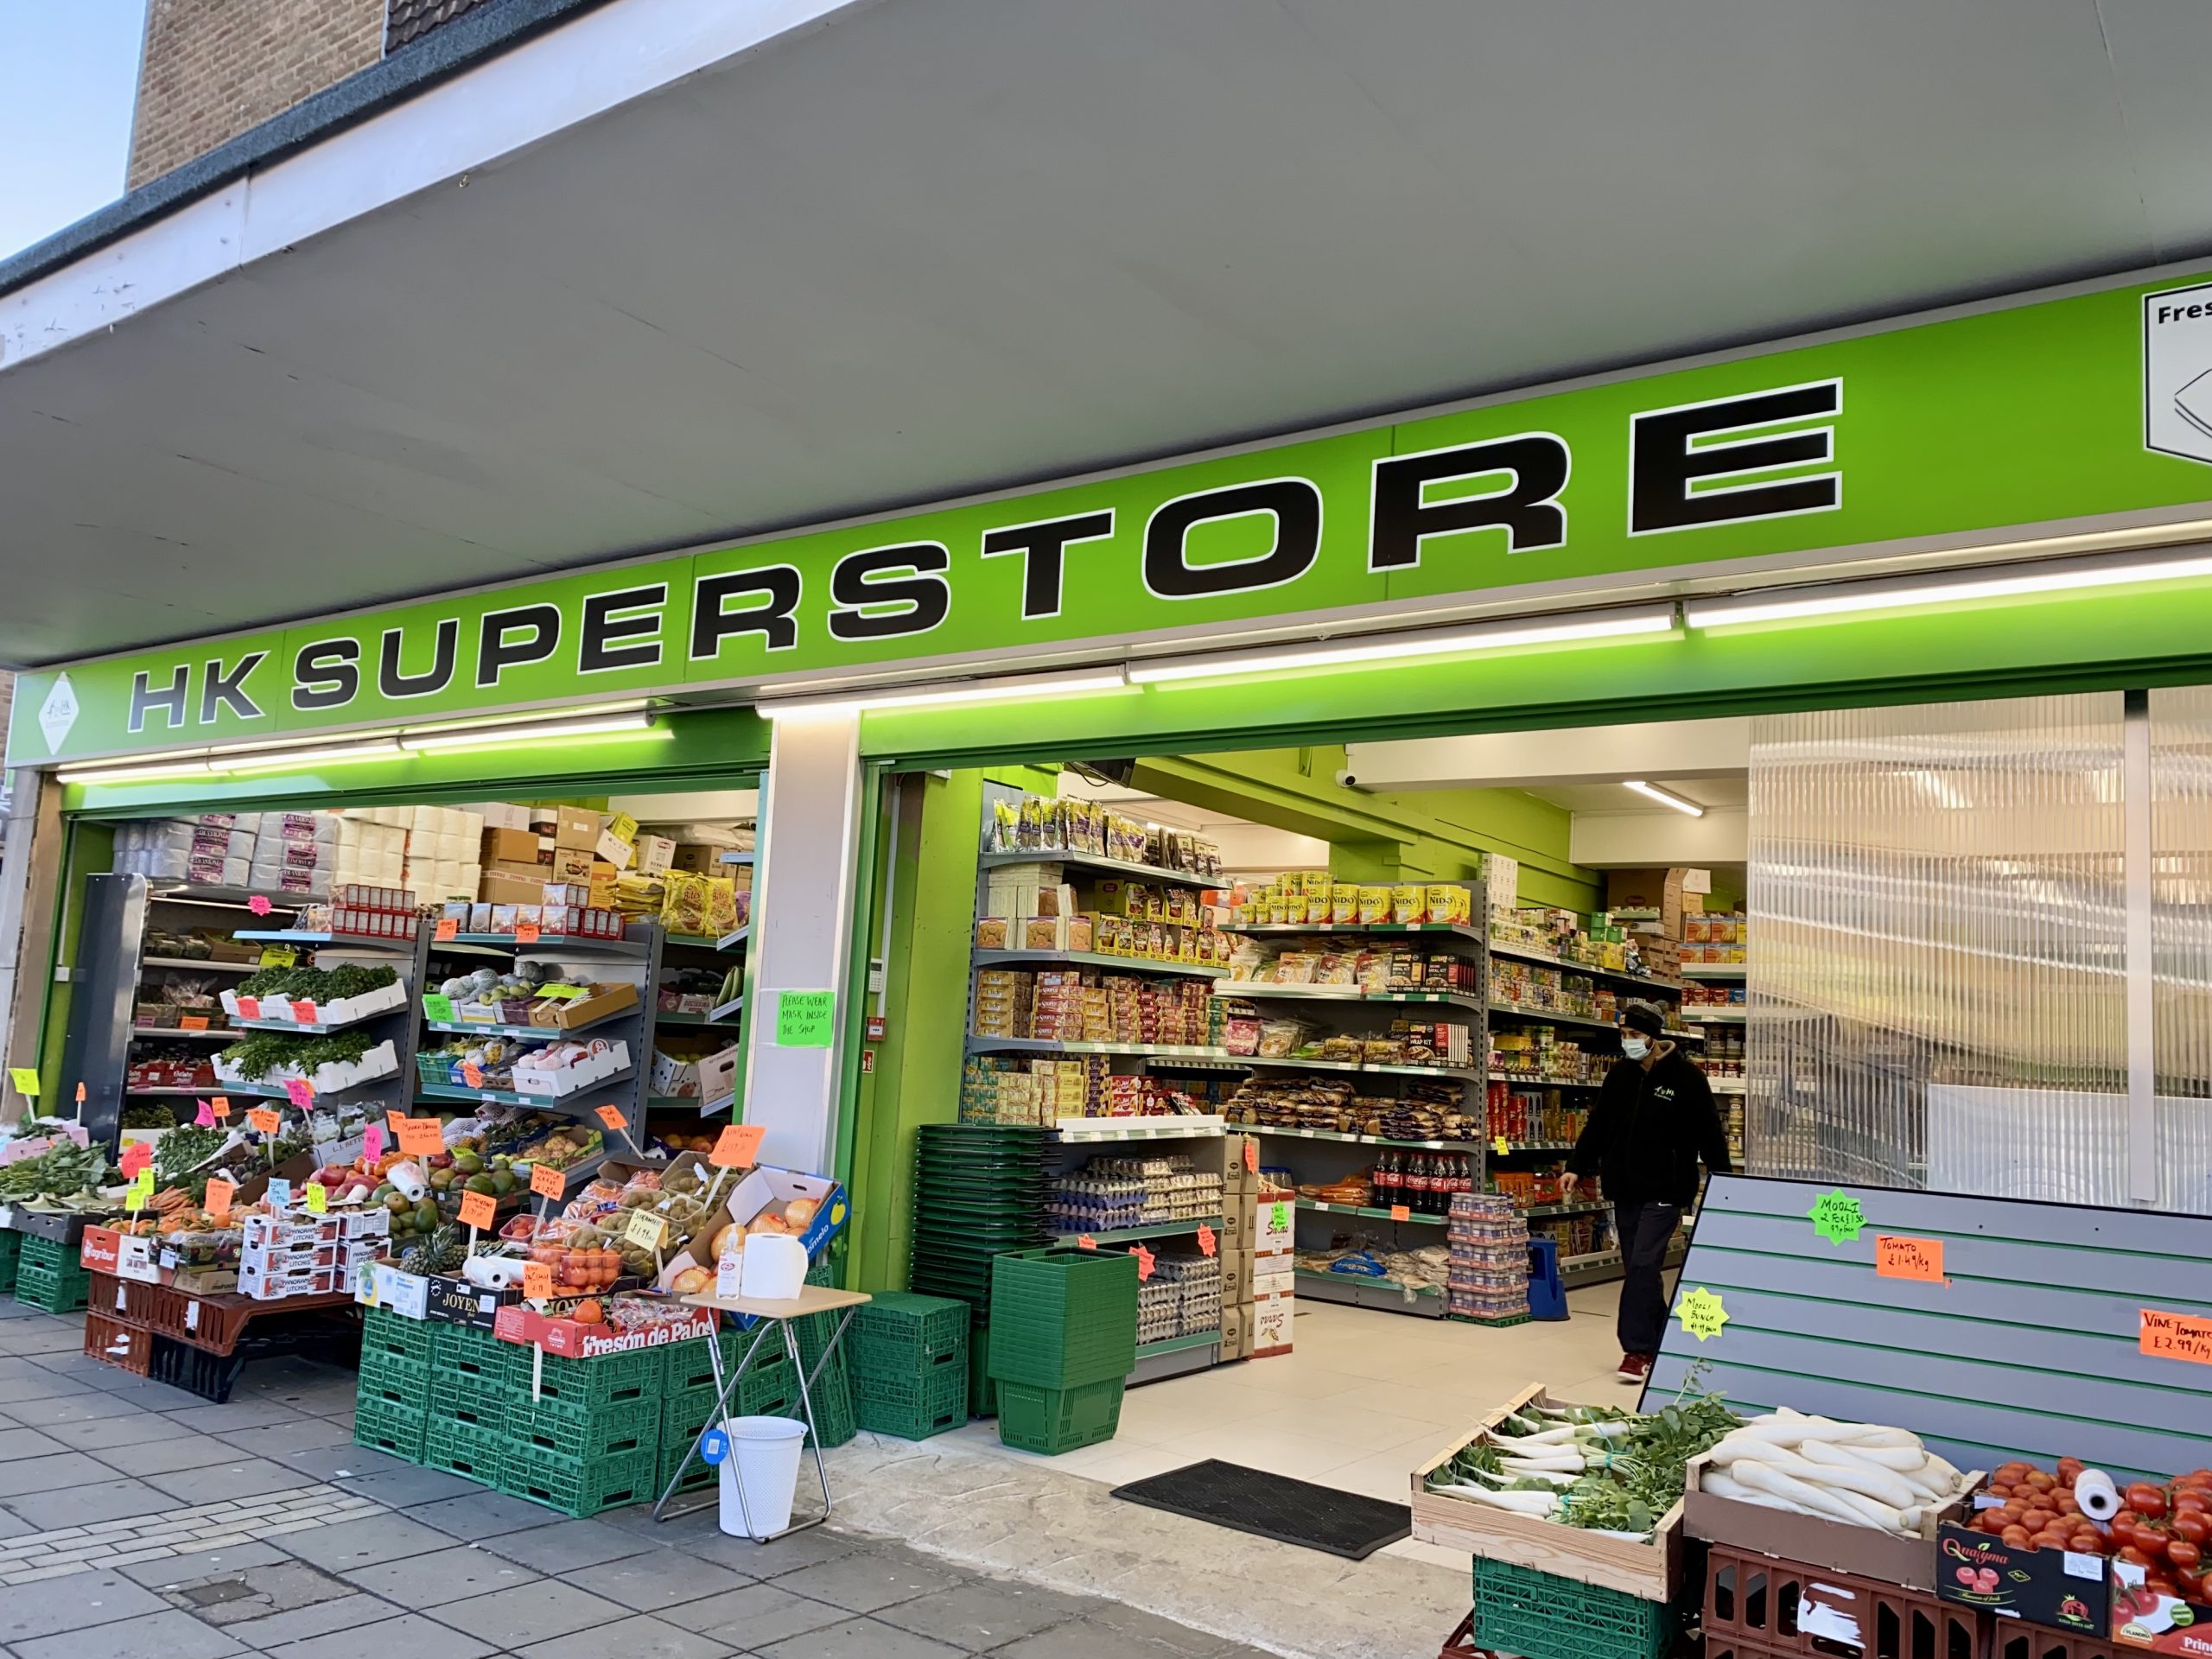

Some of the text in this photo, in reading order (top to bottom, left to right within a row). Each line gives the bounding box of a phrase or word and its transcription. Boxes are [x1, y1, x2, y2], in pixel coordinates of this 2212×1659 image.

[127, 376, 1847, 734] HK SUPERSTORE
[1395, 897, 1416, 906] NIDO
[1429, 896, 1453, 905] NIDO
[806, 995, 828, 1007] WEAR
[782, 1009, 828, 1020] MASK INSIDE
[782, 1024, 815, 1035] THE SHOP
[1820, 1198, 1859, 1213] MOOLI
[1820, 1213, 1828, 1223] 2
[807, 1224, 830, 1255] omelo
[1880, 1236, 1916, 1251] TOMATO
[289, 1259, 311, 1268] LITCHIS
[286, 1285, 308, 1294] LITCHIS
[648, 1325, 669, 1348] de
